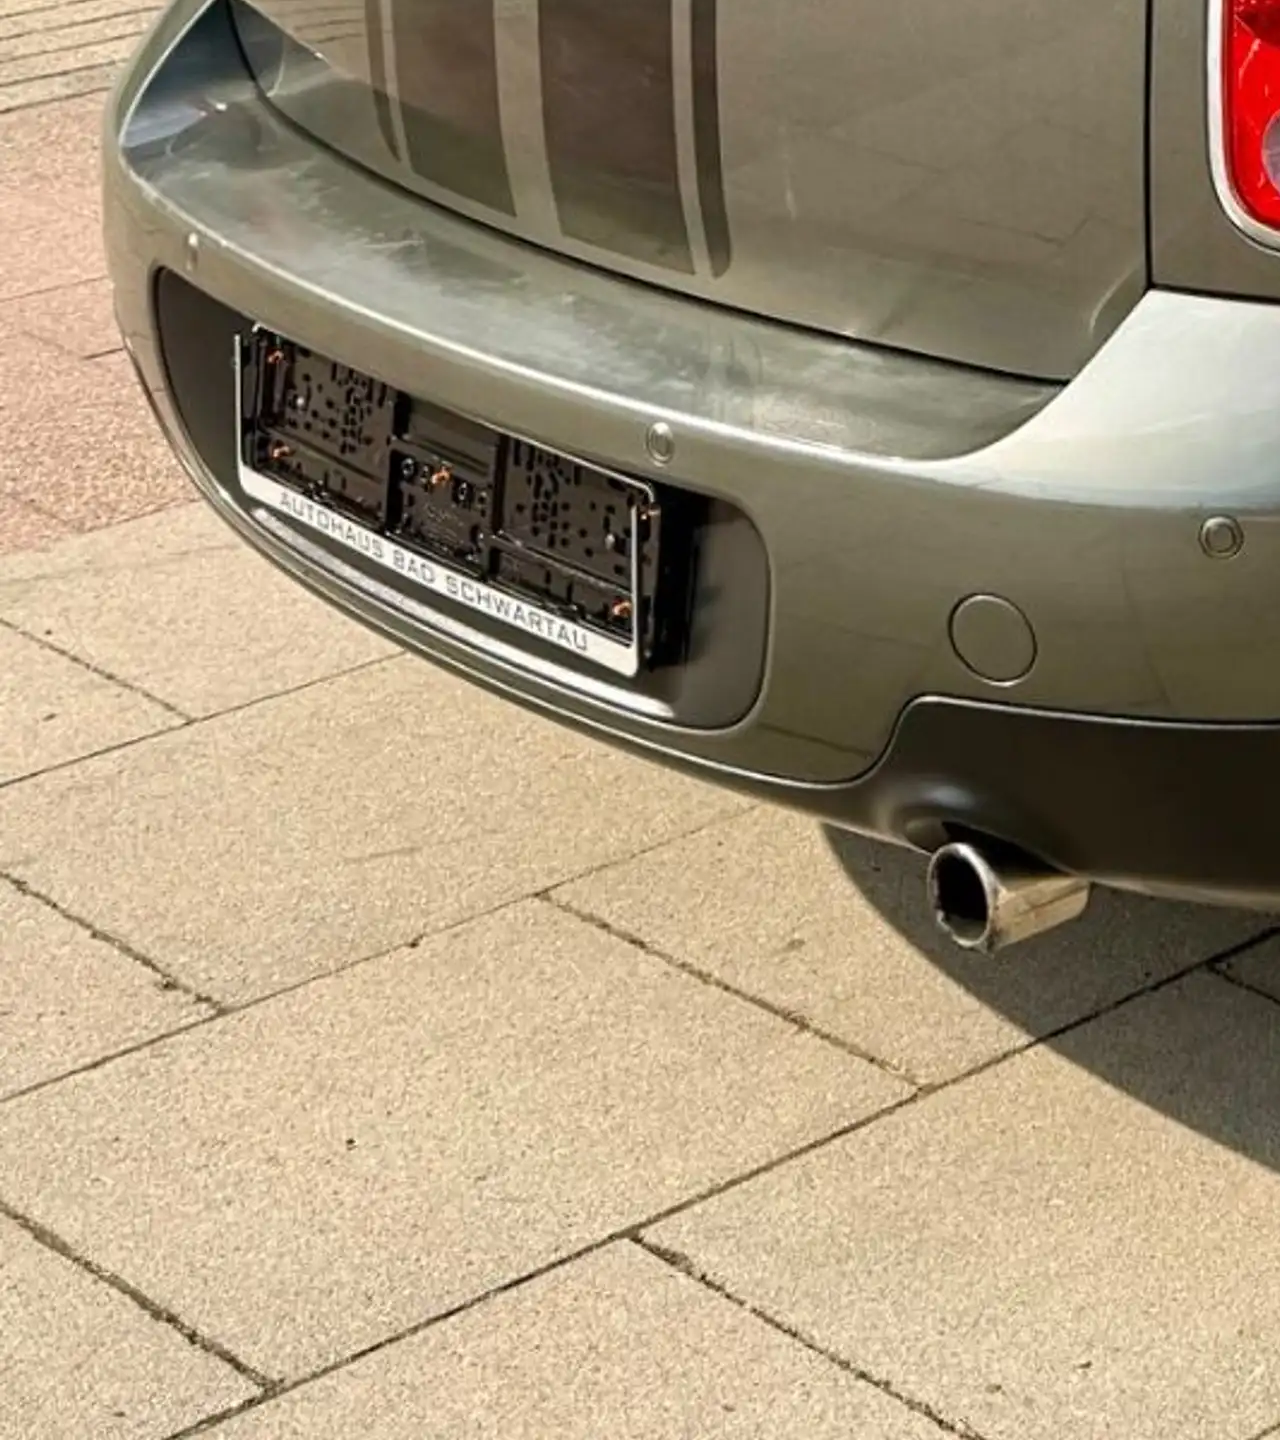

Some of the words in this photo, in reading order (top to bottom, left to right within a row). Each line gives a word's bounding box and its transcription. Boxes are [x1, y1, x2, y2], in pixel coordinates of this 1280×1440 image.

[280, 491, 385, 559] AUTOHAUS
[393, 549, 435, 584] BAD
[446, 575, 588, 652] SCHWARTAU
